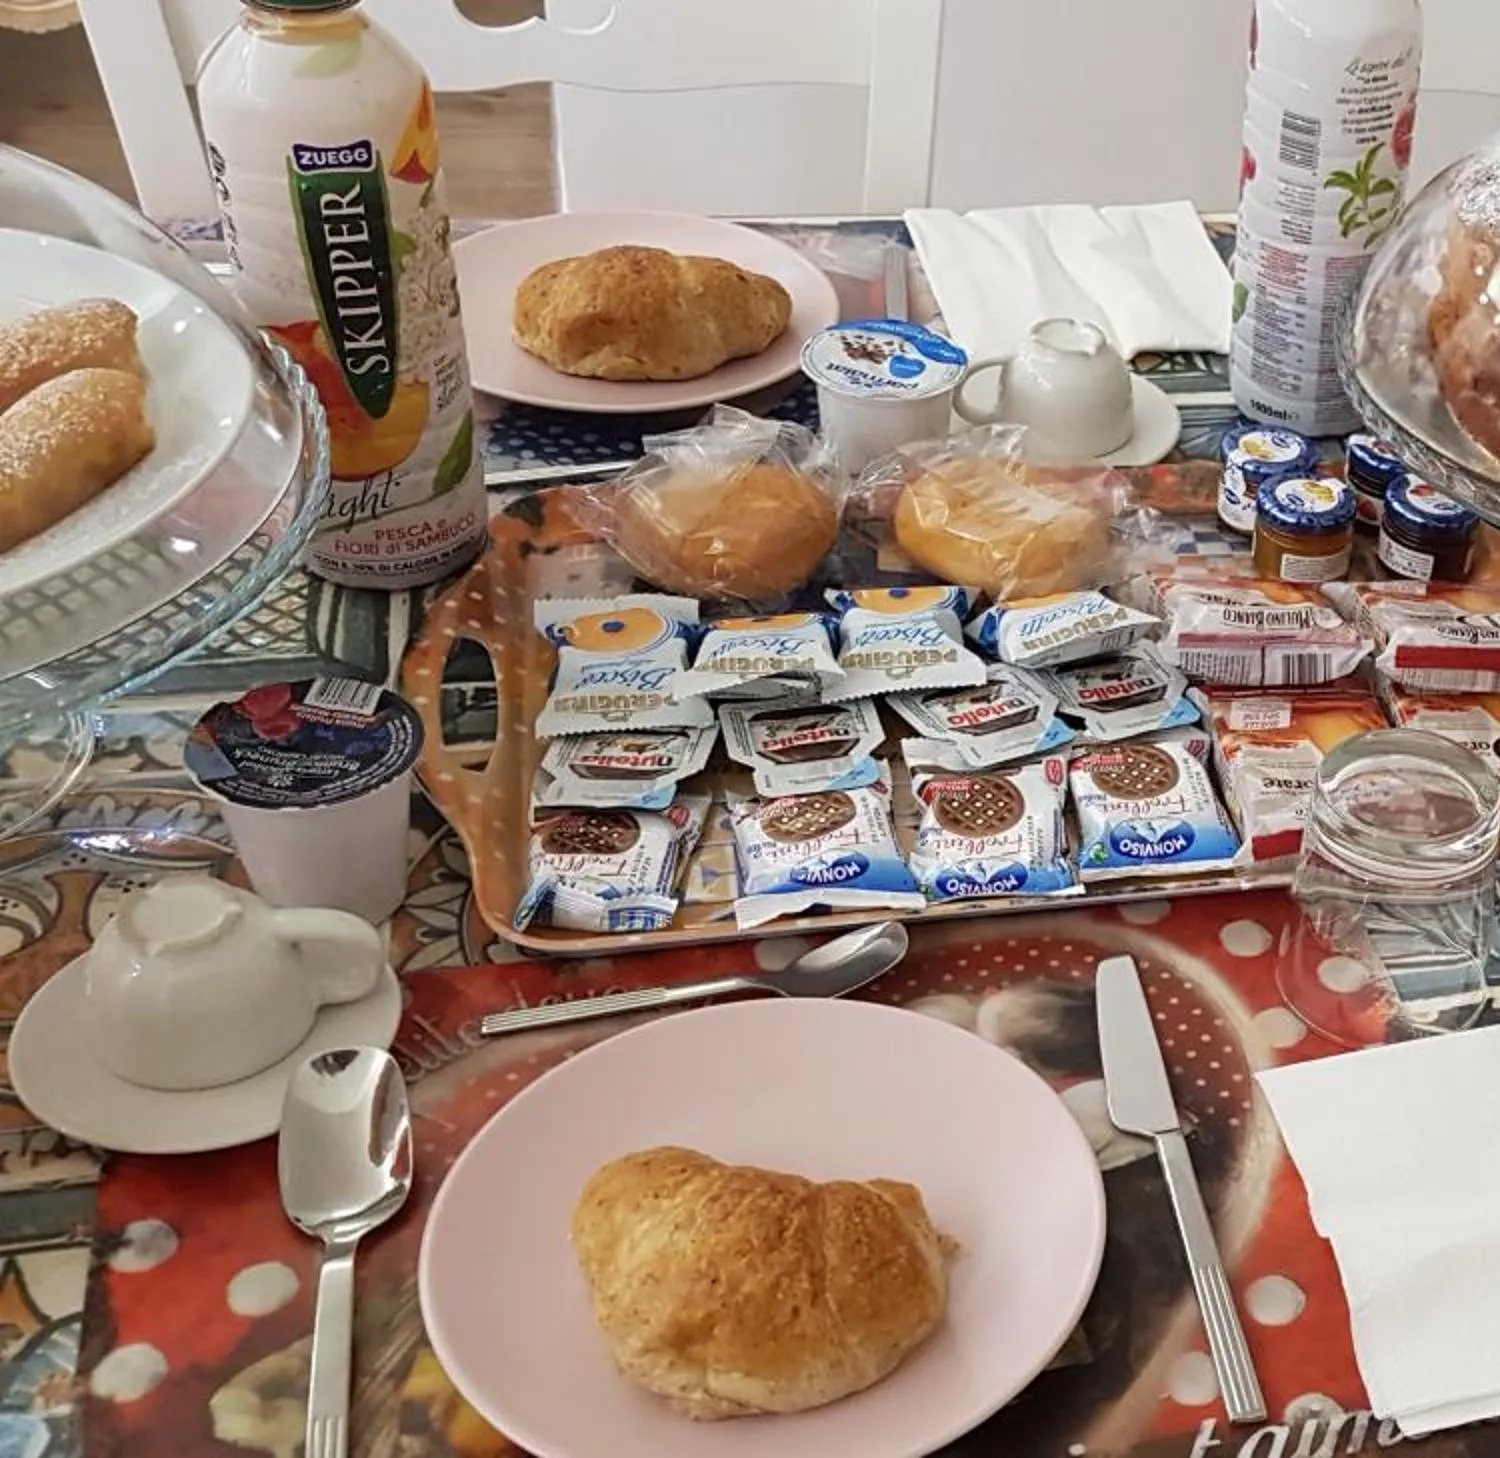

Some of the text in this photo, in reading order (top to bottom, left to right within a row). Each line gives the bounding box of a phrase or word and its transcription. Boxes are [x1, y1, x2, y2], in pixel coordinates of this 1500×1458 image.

[299, 147, 369, 166] ZUEGG
[319, 179, 391, 376] SKIPPER
[334, 538, 380, 556] FIORI
[406, 511, 476, 551] SAMBUCO
[374, 520, 432, 541] PESCA
[1021, 607, 1130, 650] PERUGINA
[840, 649, 960, 670] PERUGINA
[1077, 677, 1157, 701] nutella
[947, 698, 1026, 726] nutella
[762, 725, 850, 751] nutella
[580, 753, 673, 769] nutella
[1118, 836, 1188, 855] MONVISO
[945, 874, 1021, 897] MONVISO
